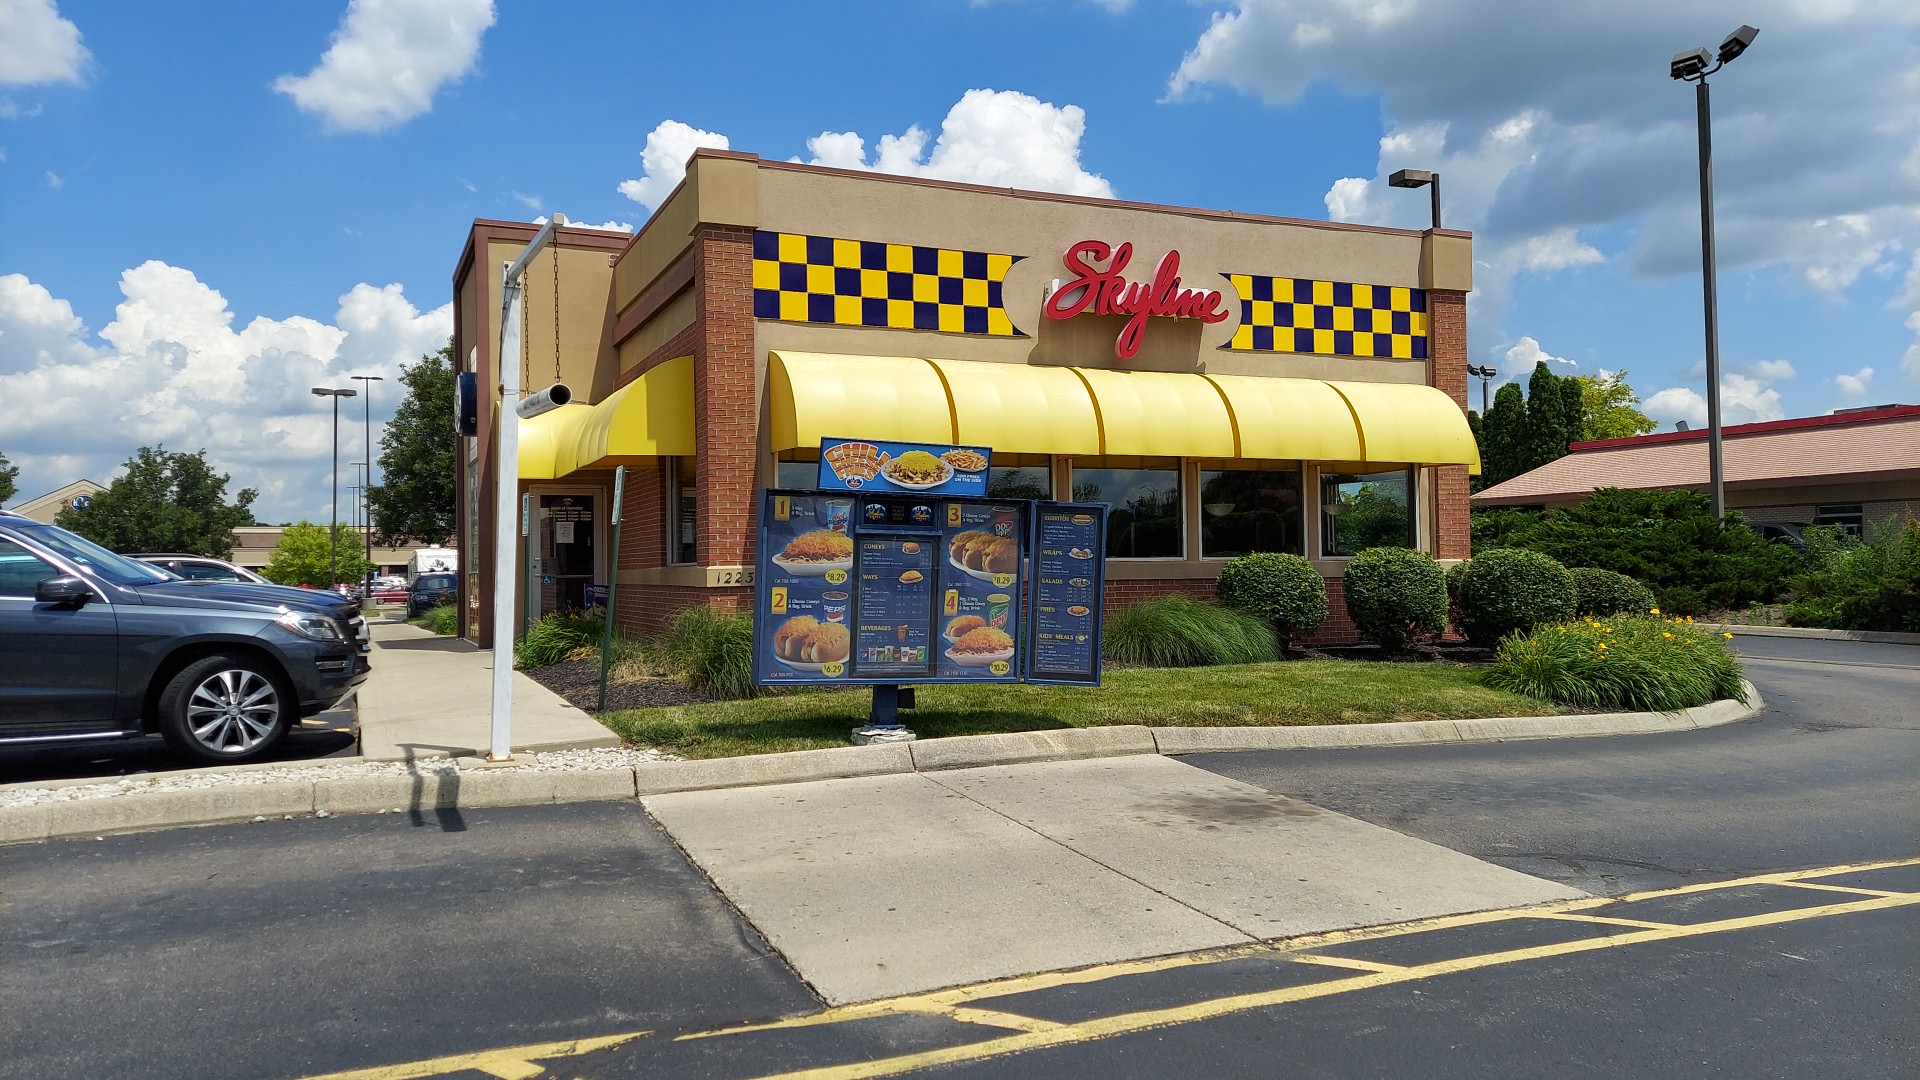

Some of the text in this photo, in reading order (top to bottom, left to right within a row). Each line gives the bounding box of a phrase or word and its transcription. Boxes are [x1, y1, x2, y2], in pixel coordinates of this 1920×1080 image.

[1044, 240, 1229, 360] Skyline
[780, 501, 785, 514] 1
[950, 508, 959, 521] 3
[828, 573, 846, 581] $8.29
[774, 593, 784, 608] 2
[946, 596, 955, 610] 4
[991, 664, 1009, 672] $10.29
